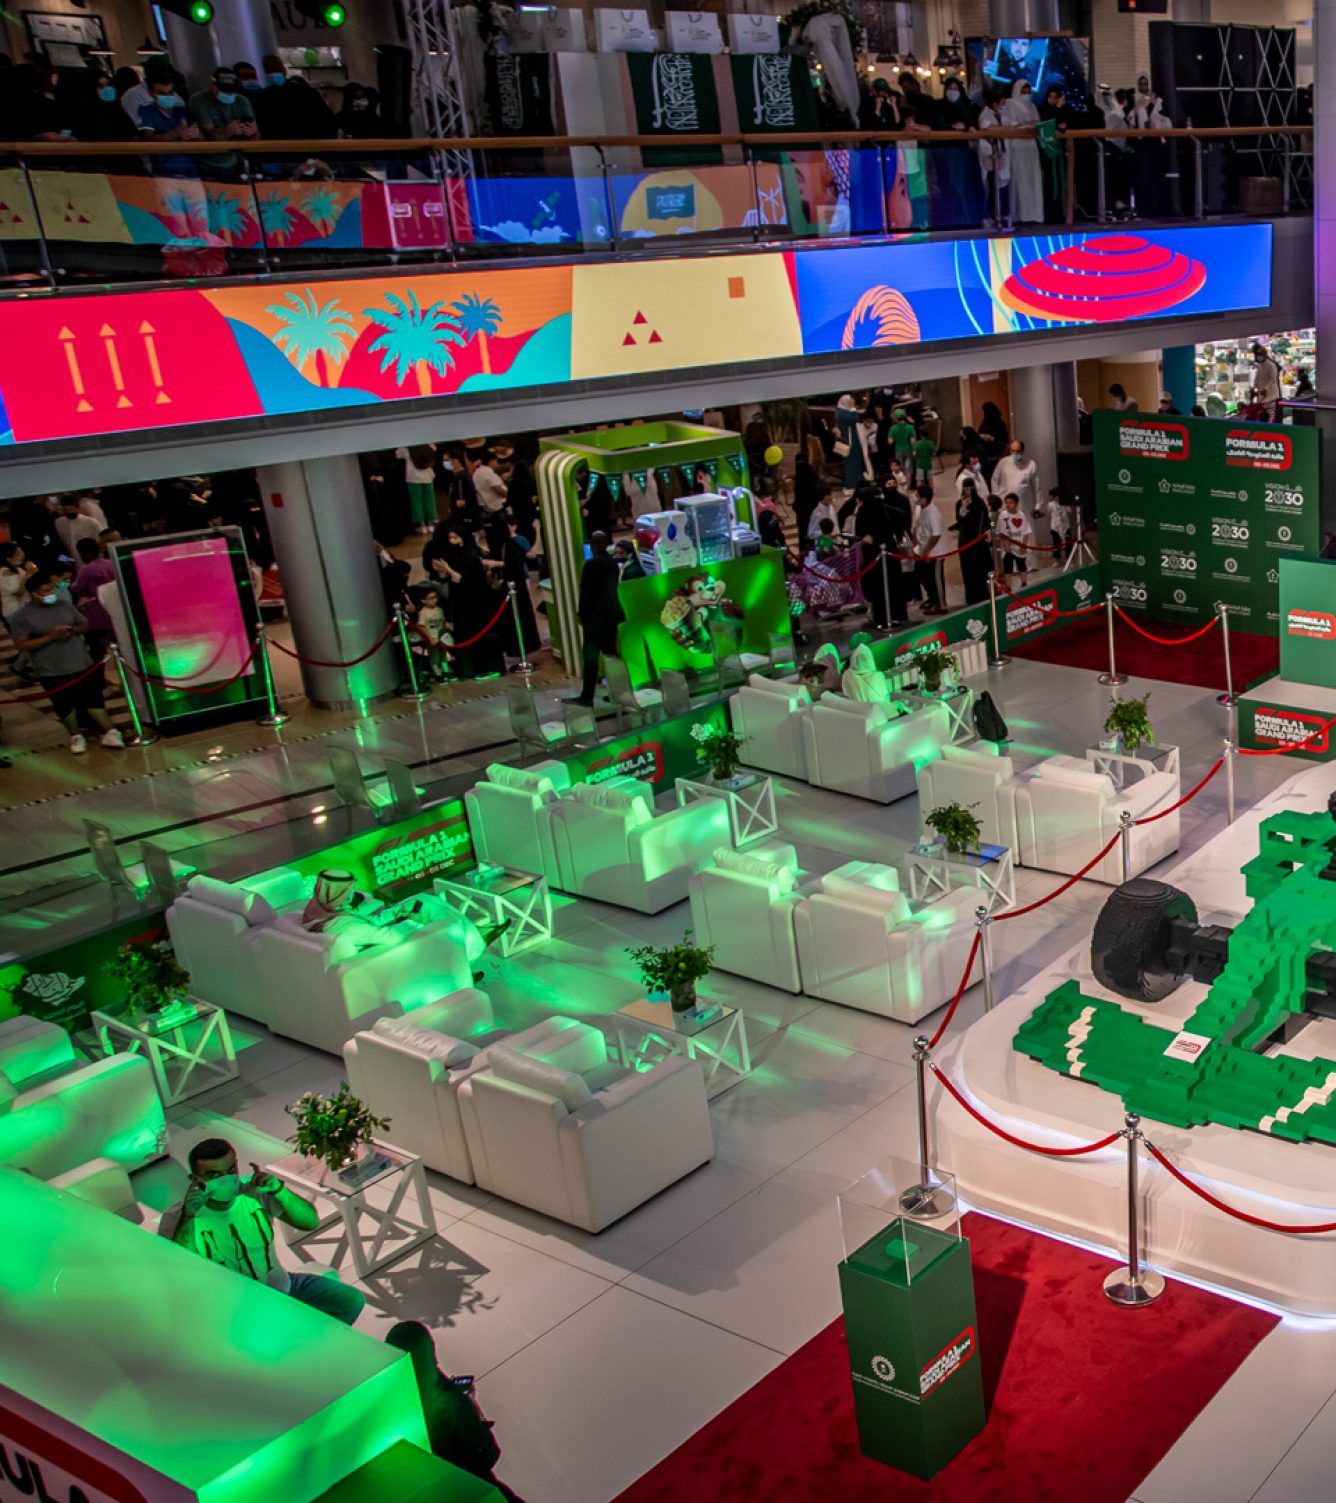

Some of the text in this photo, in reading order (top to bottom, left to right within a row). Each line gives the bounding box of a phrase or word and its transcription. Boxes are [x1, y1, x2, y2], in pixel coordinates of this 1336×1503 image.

[1120, 427, 1160, 437] FORMULA
[1120, 434, 1183, 447] SAUDI ARABIAN
[1120, 441, 1169, 452] GRAND PRIX
[1226, 438, 1284, 451] FORMULA 1
[1288, 614, 1324, 626] FORMULA
[1254, 713, 1297, 728] FORMULA
[1254, 721, 1280, 731] SAUDI
[1254, 728, 1286, 740] GRAND
[585, 752, 654, 785] FORMULA 1
[373, 831, 447, 866] FORMULA 1
[375, 855, 414, 876] SAUDI
[377, 847, 455, 885] GRAND PRIX
